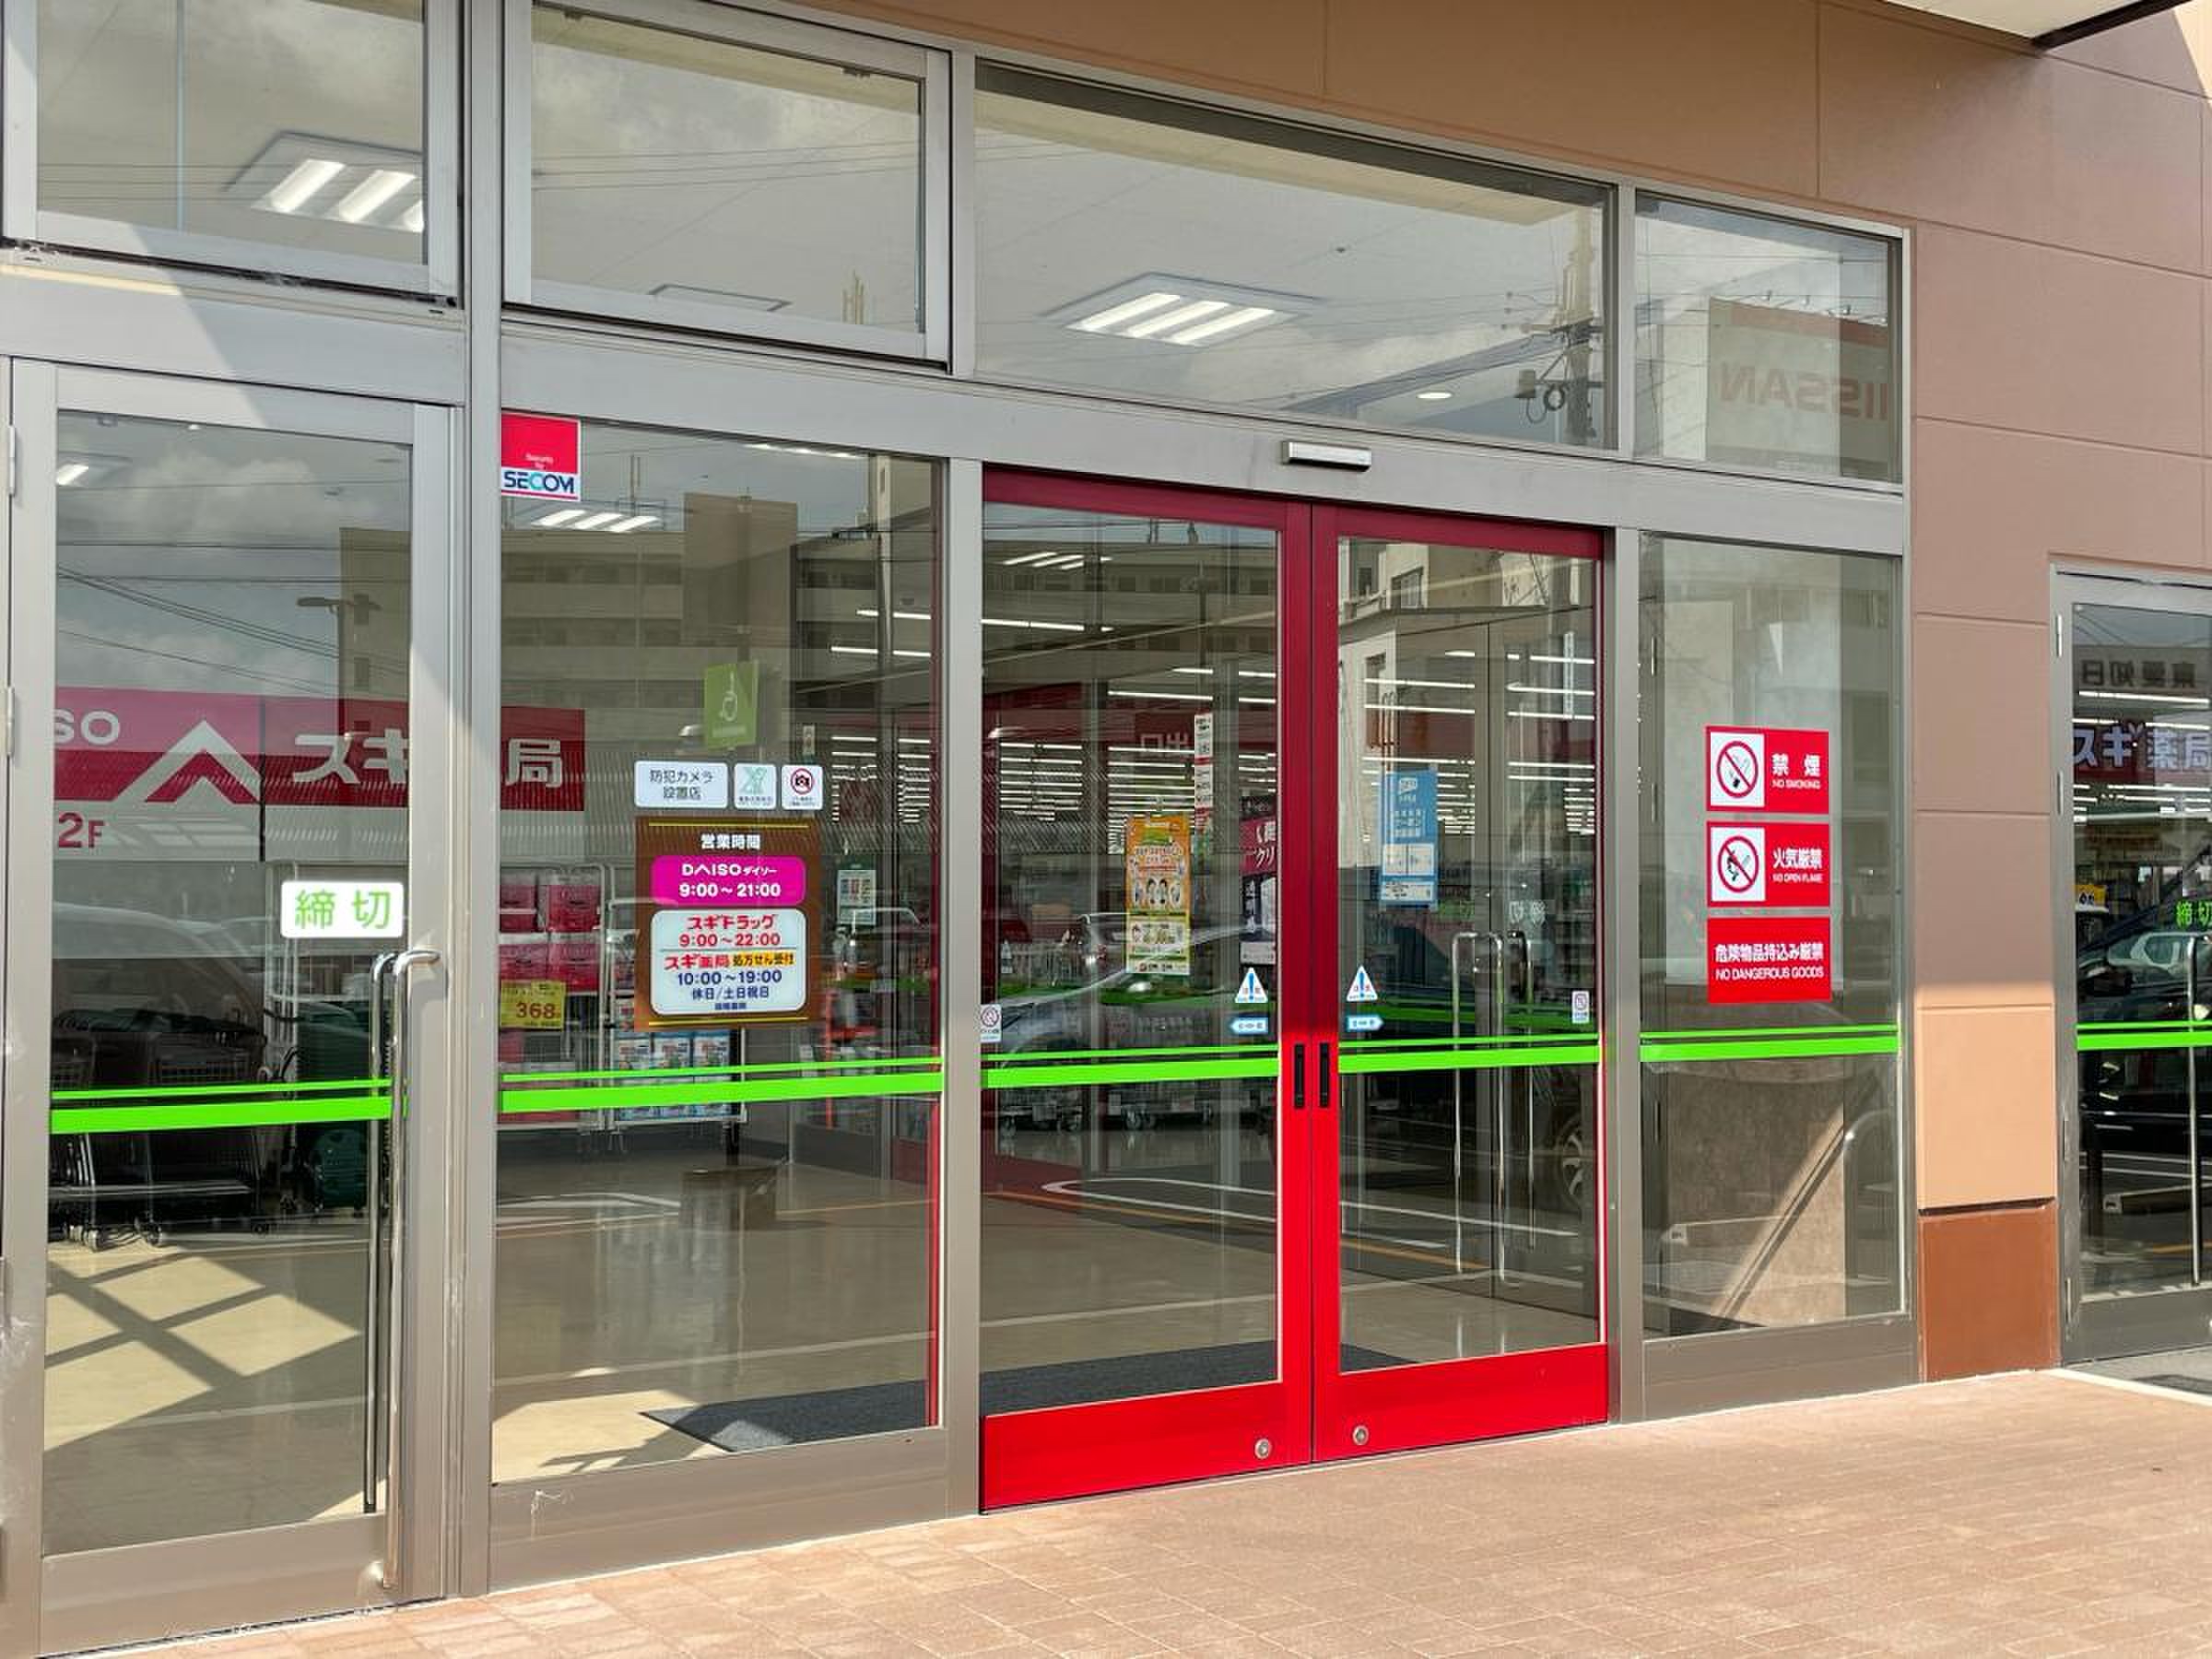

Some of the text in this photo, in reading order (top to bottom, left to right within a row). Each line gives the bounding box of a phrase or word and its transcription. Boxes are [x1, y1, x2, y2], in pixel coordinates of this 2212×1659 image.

[504, 470, 574, 494] SECOM
[1771, 753, 1821, 777] 禁煙
[650, 770, 713, 784] 防犯カメラ
[664, 786, 701, 800] 設置店
[58, 812, 104, 851] 2F
[701, 834, 761, 850] 営業時間
[682, 864, 741, 877] DAISO
[294, 888, 392, 931] 締切
[687, 913, 778, 930] スギドラッグ
[665, 954, 730, 970] スギ薬局
[1715, 966, 1824, 981] NO DANGEROUS GOODS
[515, 1002, 555, 1020] 368
